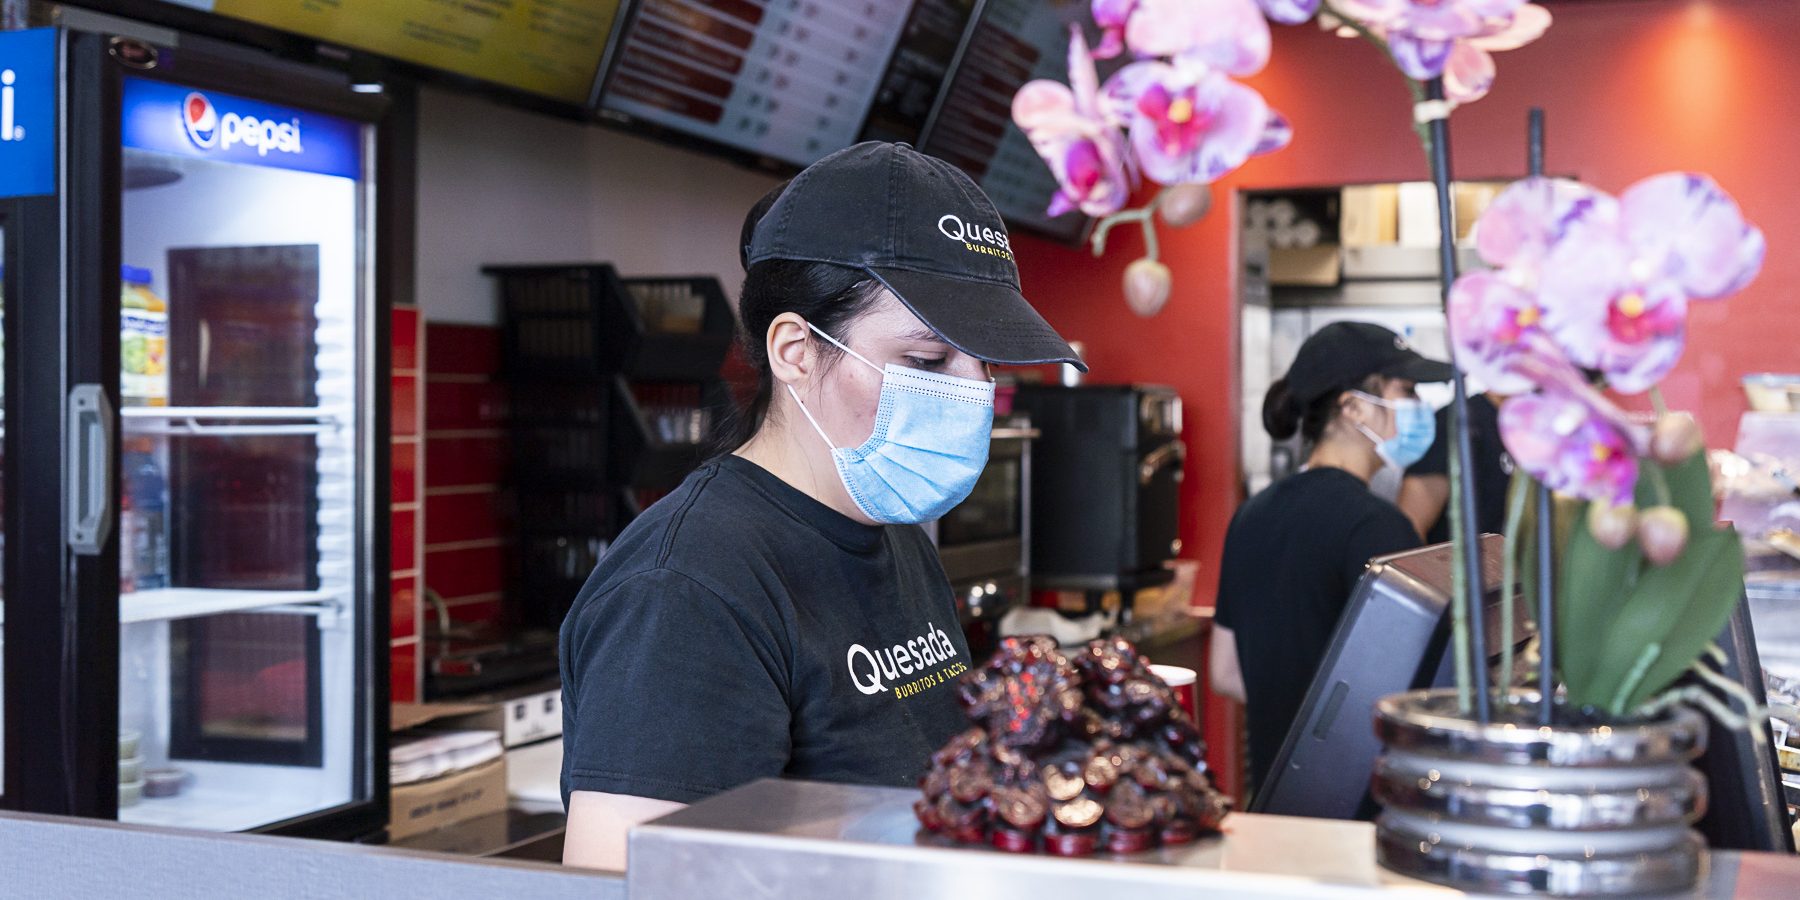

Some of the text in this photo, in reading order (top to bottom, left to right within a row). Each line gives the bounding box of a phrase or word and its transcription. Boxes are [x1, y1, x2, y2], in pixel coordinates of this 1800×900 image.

[221, 112, 301, 156] pepsi
[847, 621, 957, 695] Quesada
[894, 661, 967, 700] BURRITOS & TACOS
